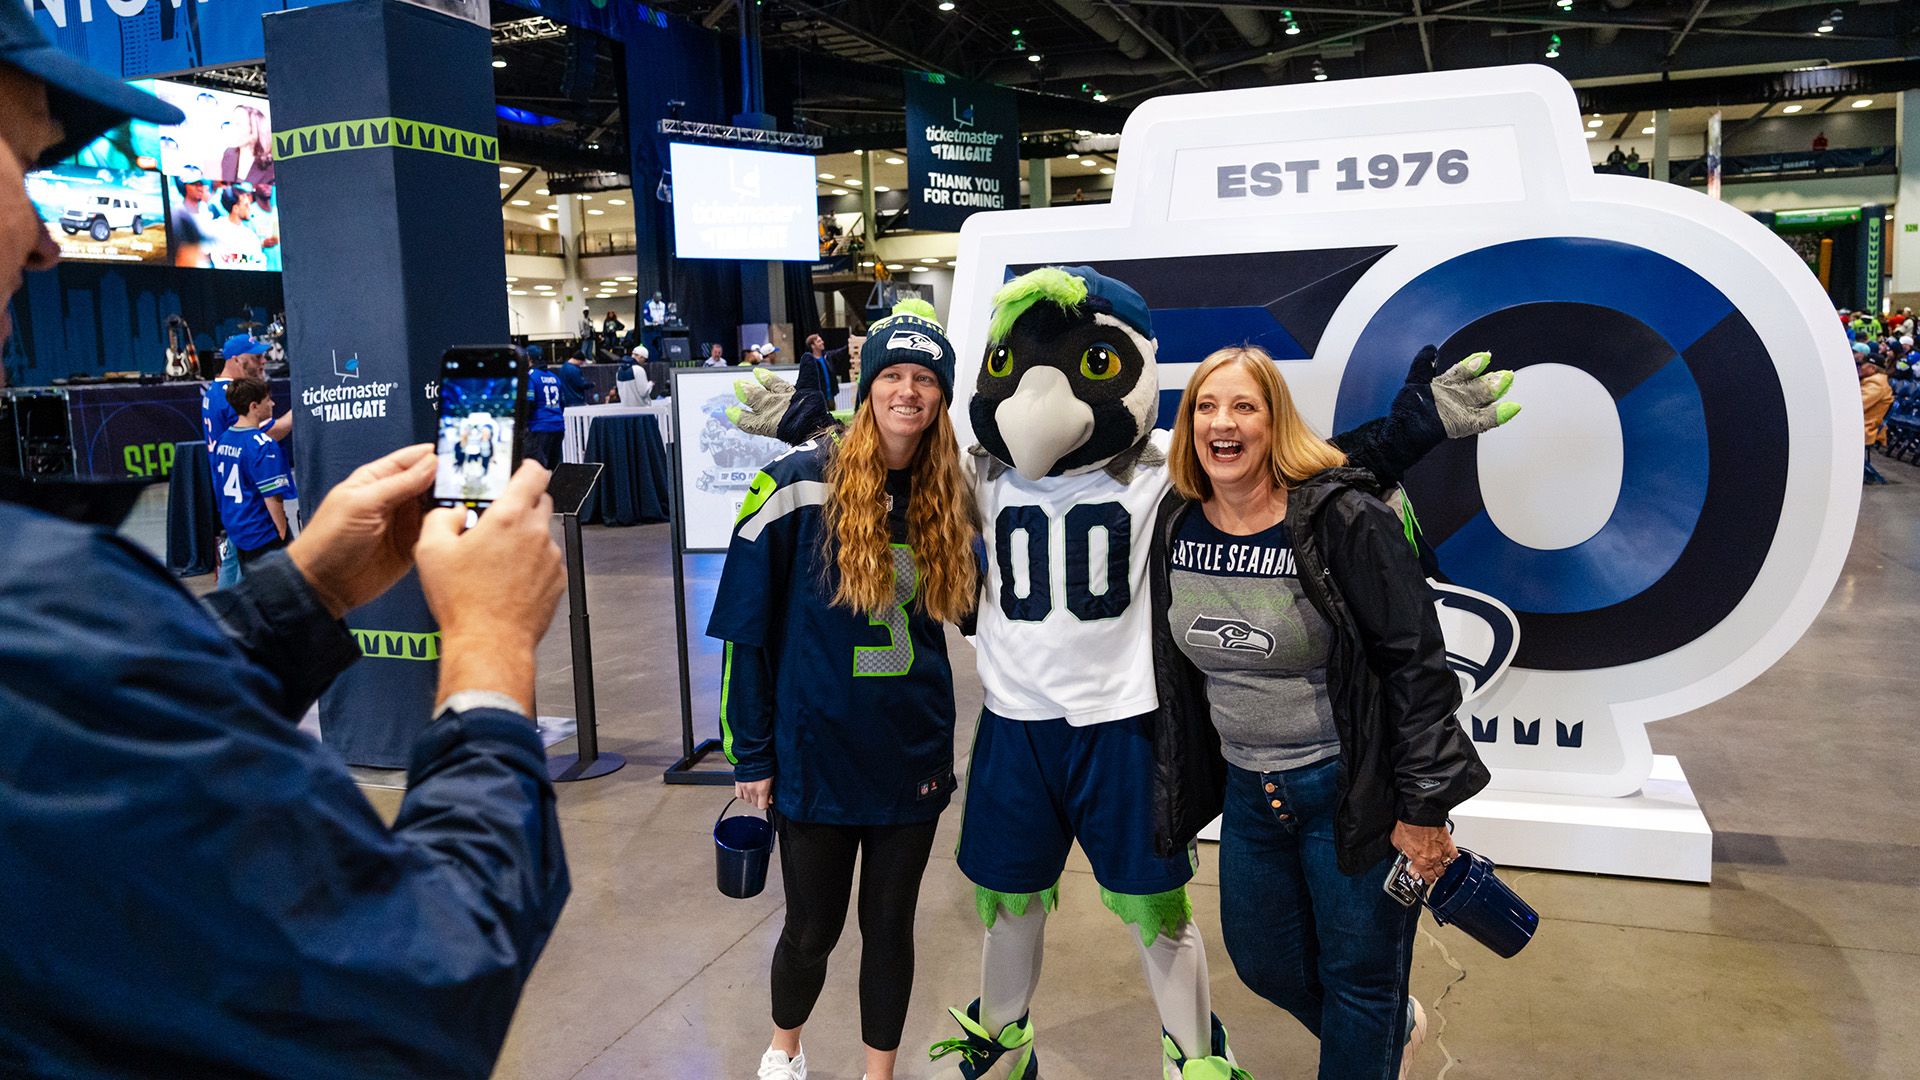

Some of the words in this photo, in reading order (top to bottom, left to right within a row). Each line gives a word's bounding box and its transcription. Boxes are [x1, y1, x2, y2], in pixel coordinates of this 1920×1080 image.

[941, 144, 993, 162] TAILGATE
[928, 172, 973, 190] THANK
[975, 177, 1000, 193] YOU
[1217, 160, 1320, 198] EST
[1336, 149, 1469, 191] 1976
[923, 188, 950, 205] FOR
[952, 191, 1004, 209] COMING!
[324, 400, 386, 422] TAILGATE
[253, 432, 273, 446] 14
[217, 461, 243, 504] 14
[730, 472, 747, 481] 50
[995, 501, 1132, 623] 00
[1170, 539, 1224, 571] EATTLE
[853, 543, 919, 677] 3
